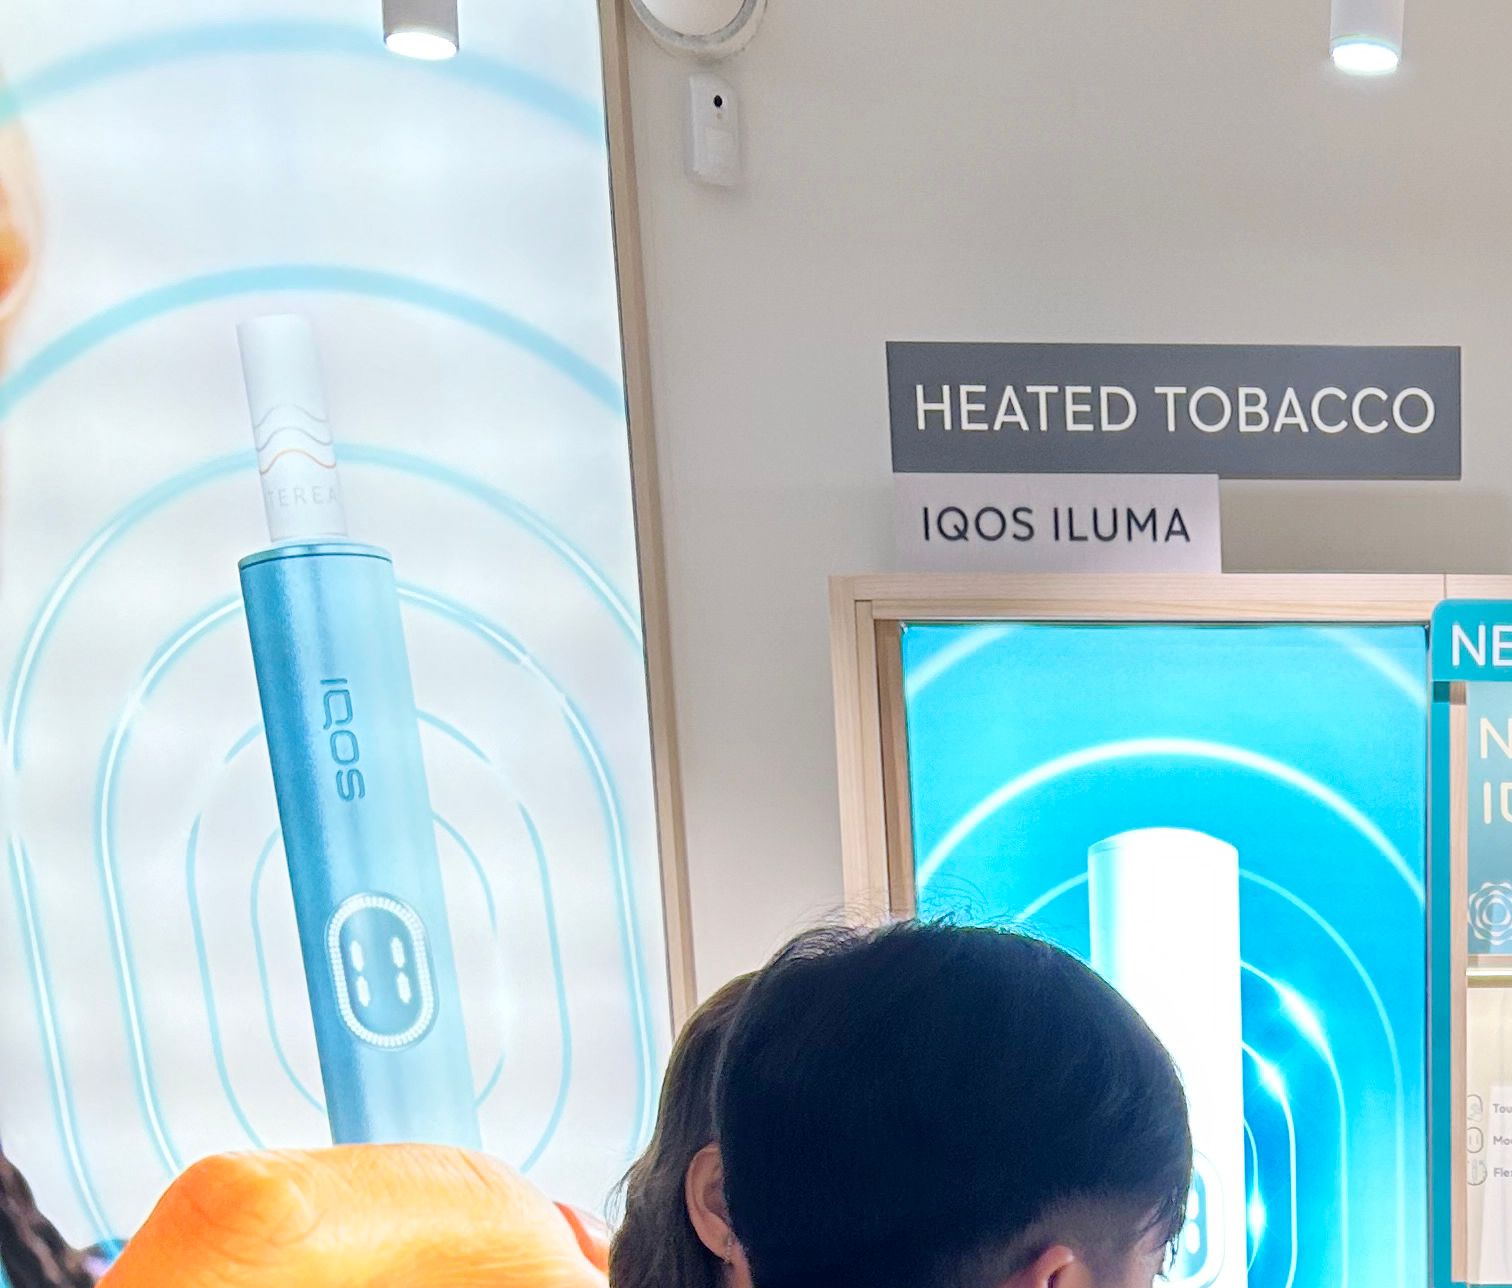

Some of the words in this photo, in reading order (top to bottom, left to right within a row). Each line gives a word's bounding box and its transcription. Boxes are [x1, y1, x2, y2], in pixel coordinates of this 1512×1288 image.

[915, 384, 1136, 432] HEATED
[1153, 385, 1436, 434] TOBACCO
[923, 506, 1034, 542] IQOS
[1053, 506, 1191, 543] ILUMA
[320, 677, 366, 801] IQOS
